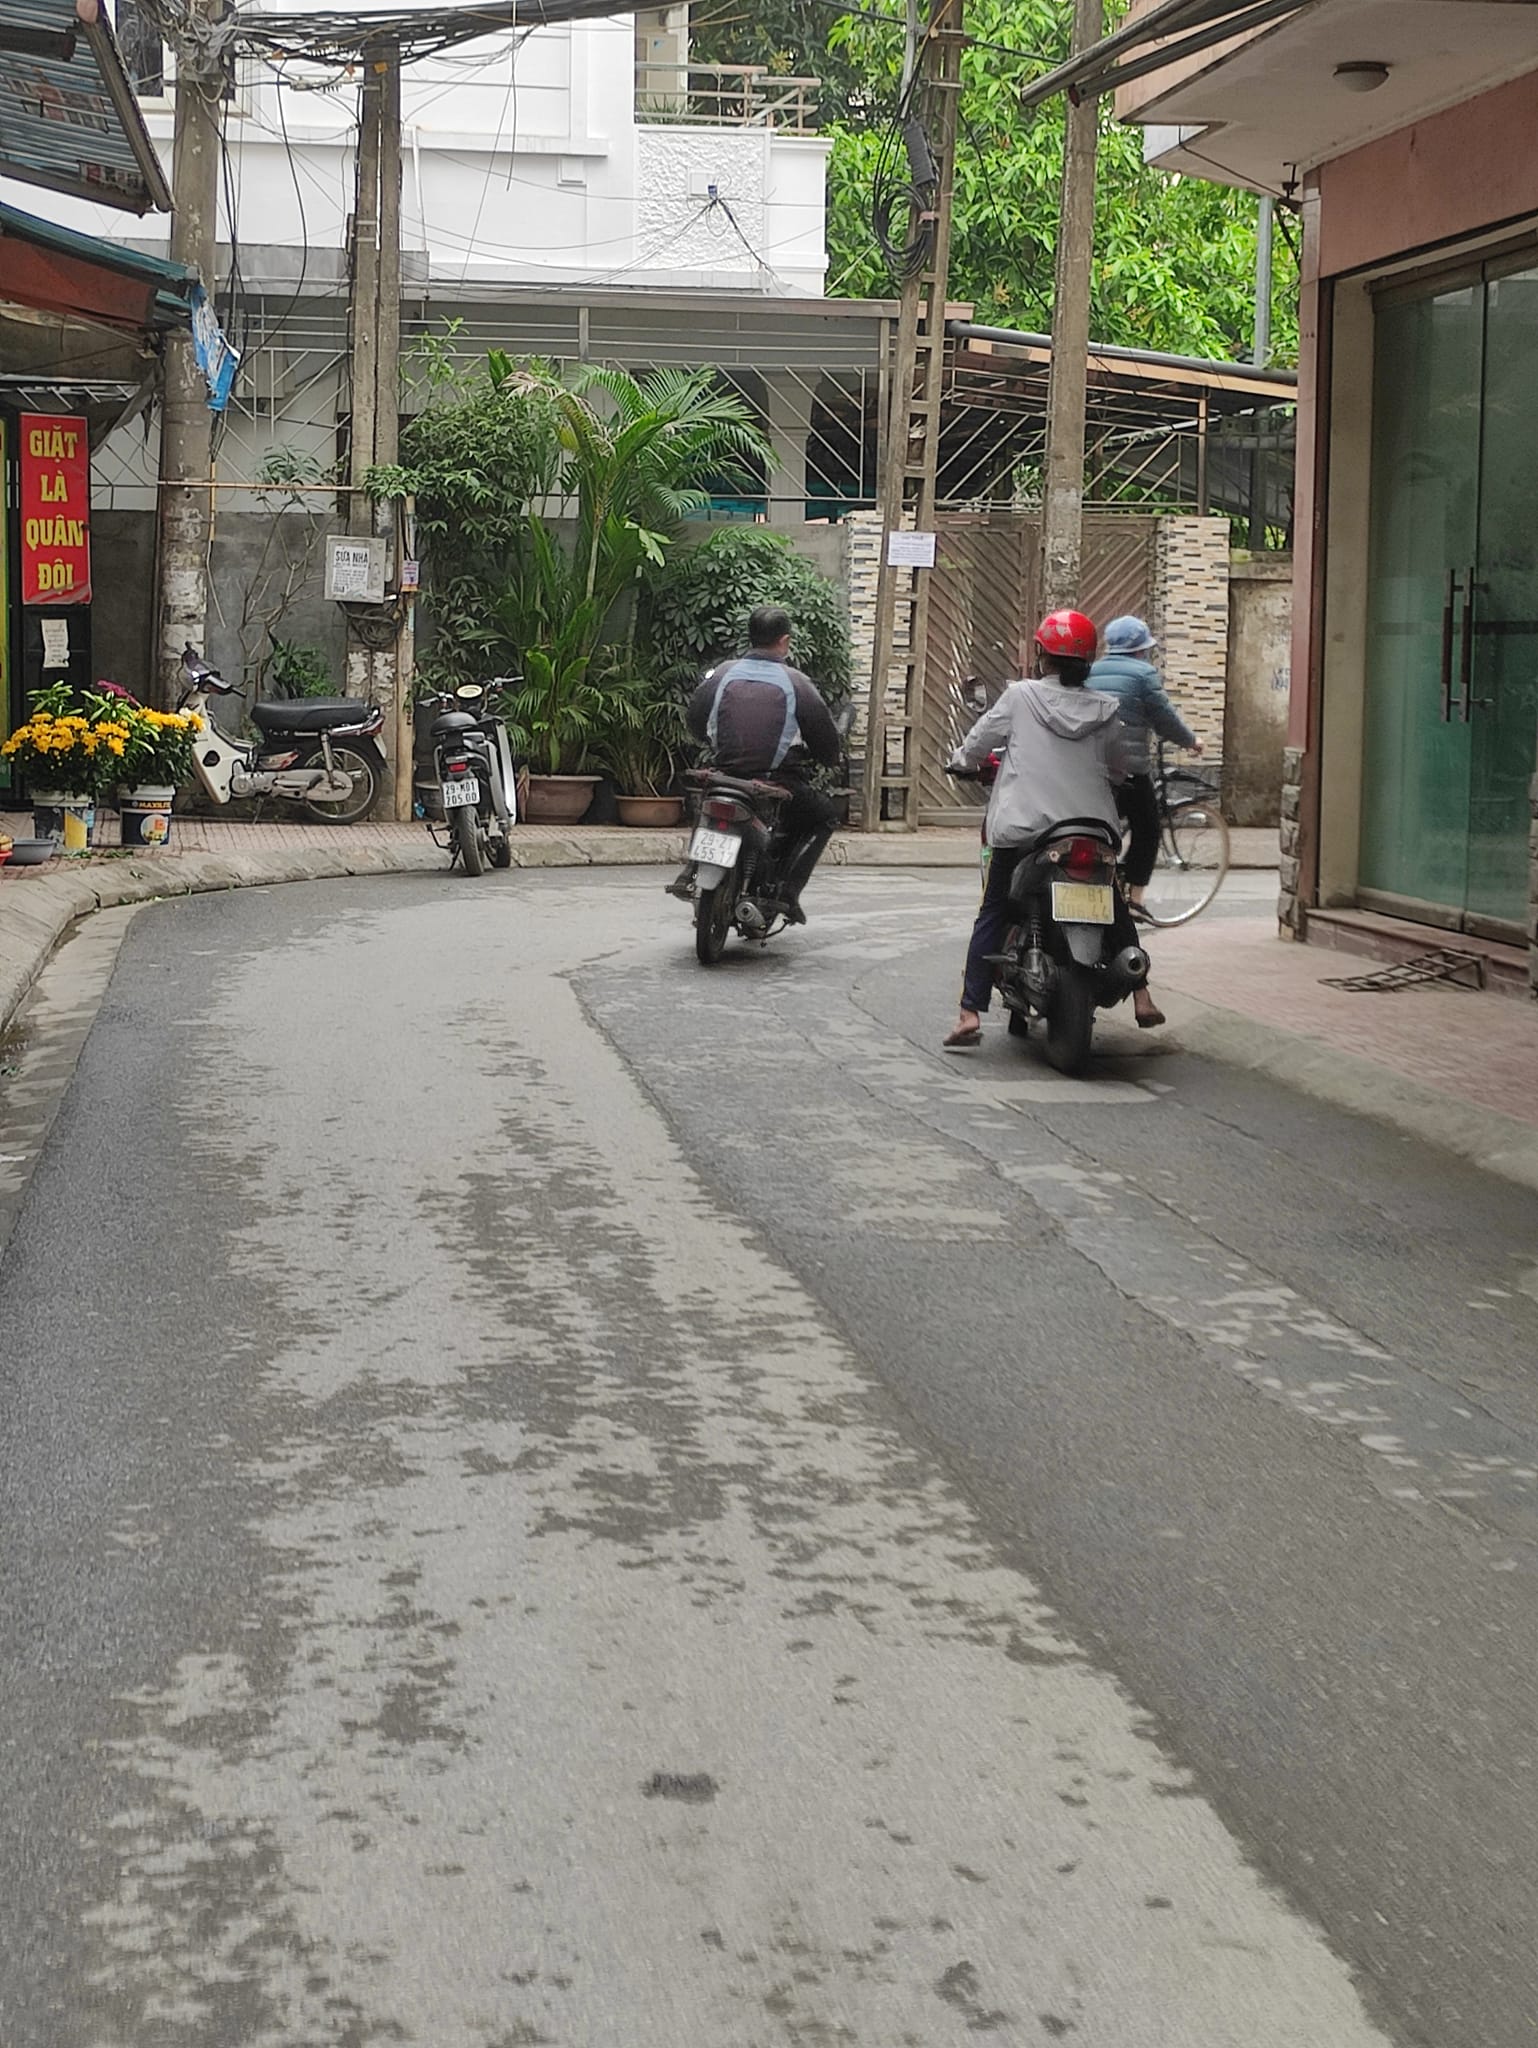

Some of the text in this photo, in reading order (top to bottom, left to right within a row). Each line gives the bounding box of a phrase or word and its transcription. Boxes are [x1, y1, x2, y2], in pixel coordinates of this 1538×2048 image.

[29, 425, 78, 463] GIẶT
[40, 470, 68, 502] LÀ
[25, 514, 84, 551] QUÂN
[38, 558, 74, 595] ĐỘI
